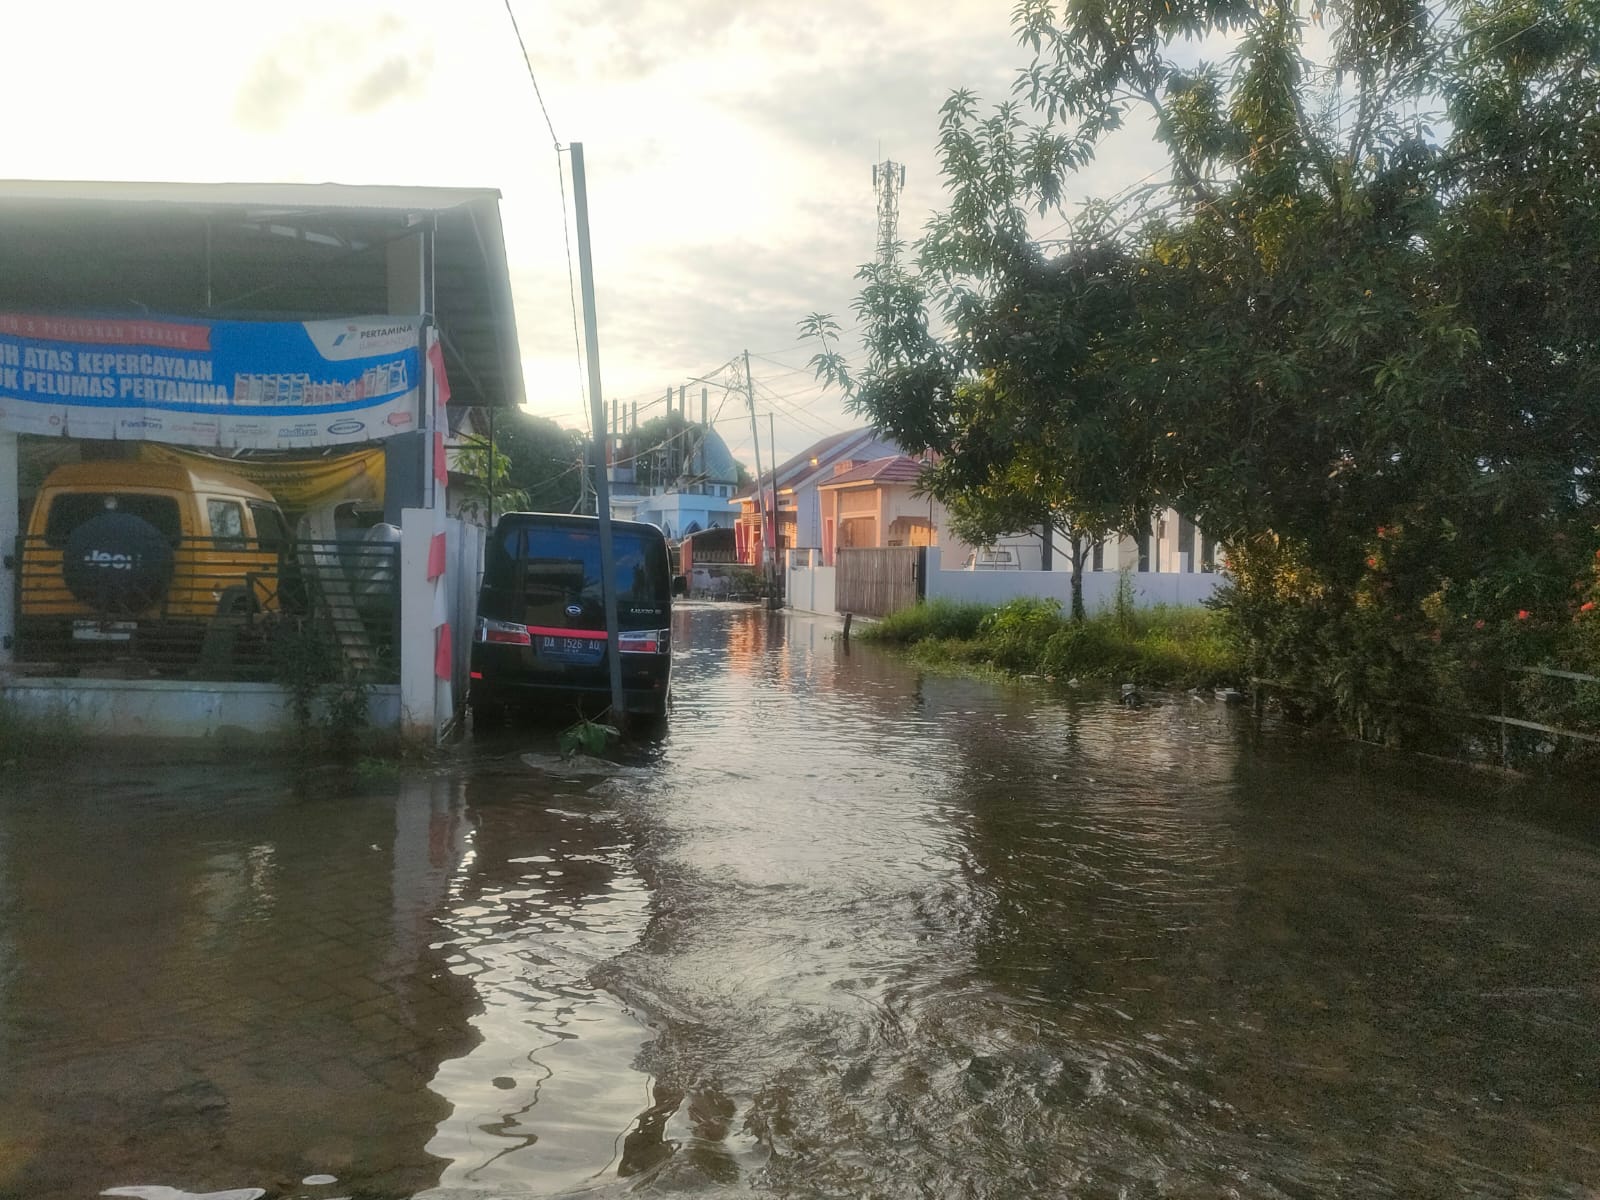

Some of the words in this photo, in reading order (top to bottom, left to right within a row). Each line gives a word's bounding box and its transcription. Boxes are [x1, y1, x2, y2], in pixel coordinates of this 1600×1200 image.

[360, 324, 413, 340] PERTAMINA
[24, 347, 74, 372] ATAS
[78, 352, 213, 381] KEPERCAYAAN
[22, 370, 116, 398] PELUMAS
[120, 378, 228, 405] PERTAMINA
[544, 637, 555, 647] DA
[563, 638, 583, 649] 1526
